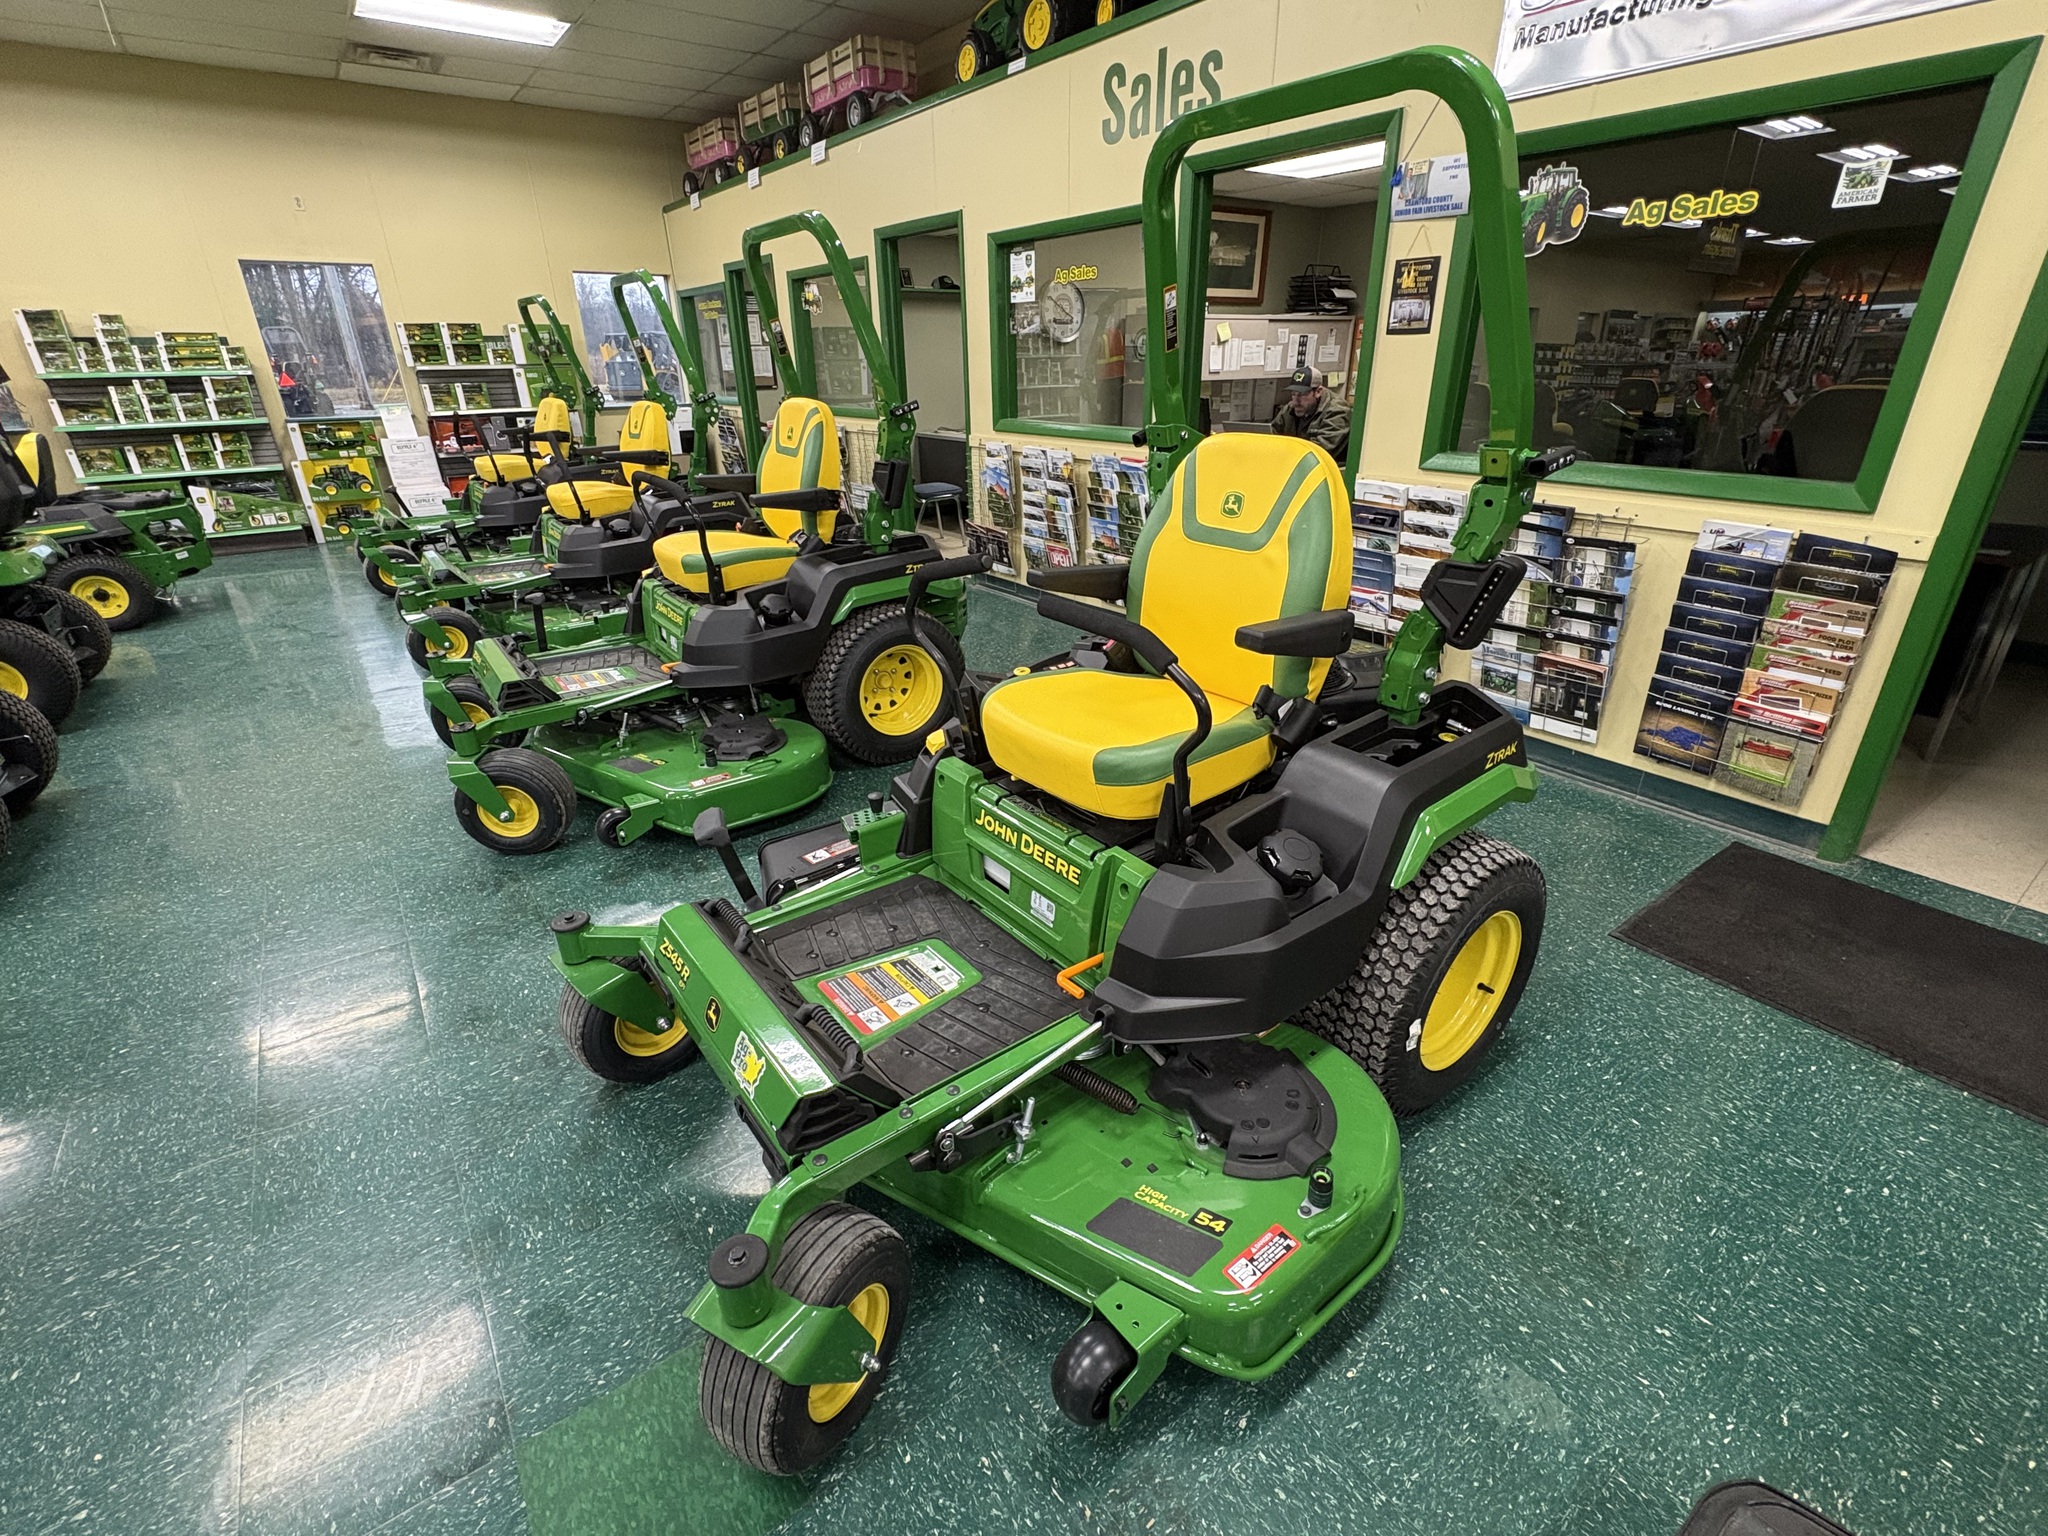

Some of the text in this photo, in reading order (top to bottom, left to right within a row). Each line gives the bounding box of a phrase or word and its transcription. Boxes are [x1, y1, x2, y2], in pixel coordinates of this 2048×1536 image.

[1102, 46, 1223, 145] Sales
[1836, 194, 1877, 205] FARMER
[1839, 188, 1879, 197] AMERICAN
[1405, 195, 1453, 207] CRAWFORD COUNTY
[1622, 189, 1759, 227] Ag Sales
[1394, 202, 1463, 217] JUNIOR FAIR LIVESTOCK SALE
[1054, 264, 1098, 284] Ag Sales
[712, 500, 735, 508] ZTRAK
[1818, 634, 1856, 646] FOOD PLOT
[1763, 711, 1792, 722] Brillion
[1485, 741, 1518, 770] ZTRAK
[975, 808, 1018, 850] JOHN
[1020, 834, 1082, 886] DEERE
[1138, 1184, 1168, 1201] HIGH
[1134, 1191, 1226, 1233] CAPACITY 54
